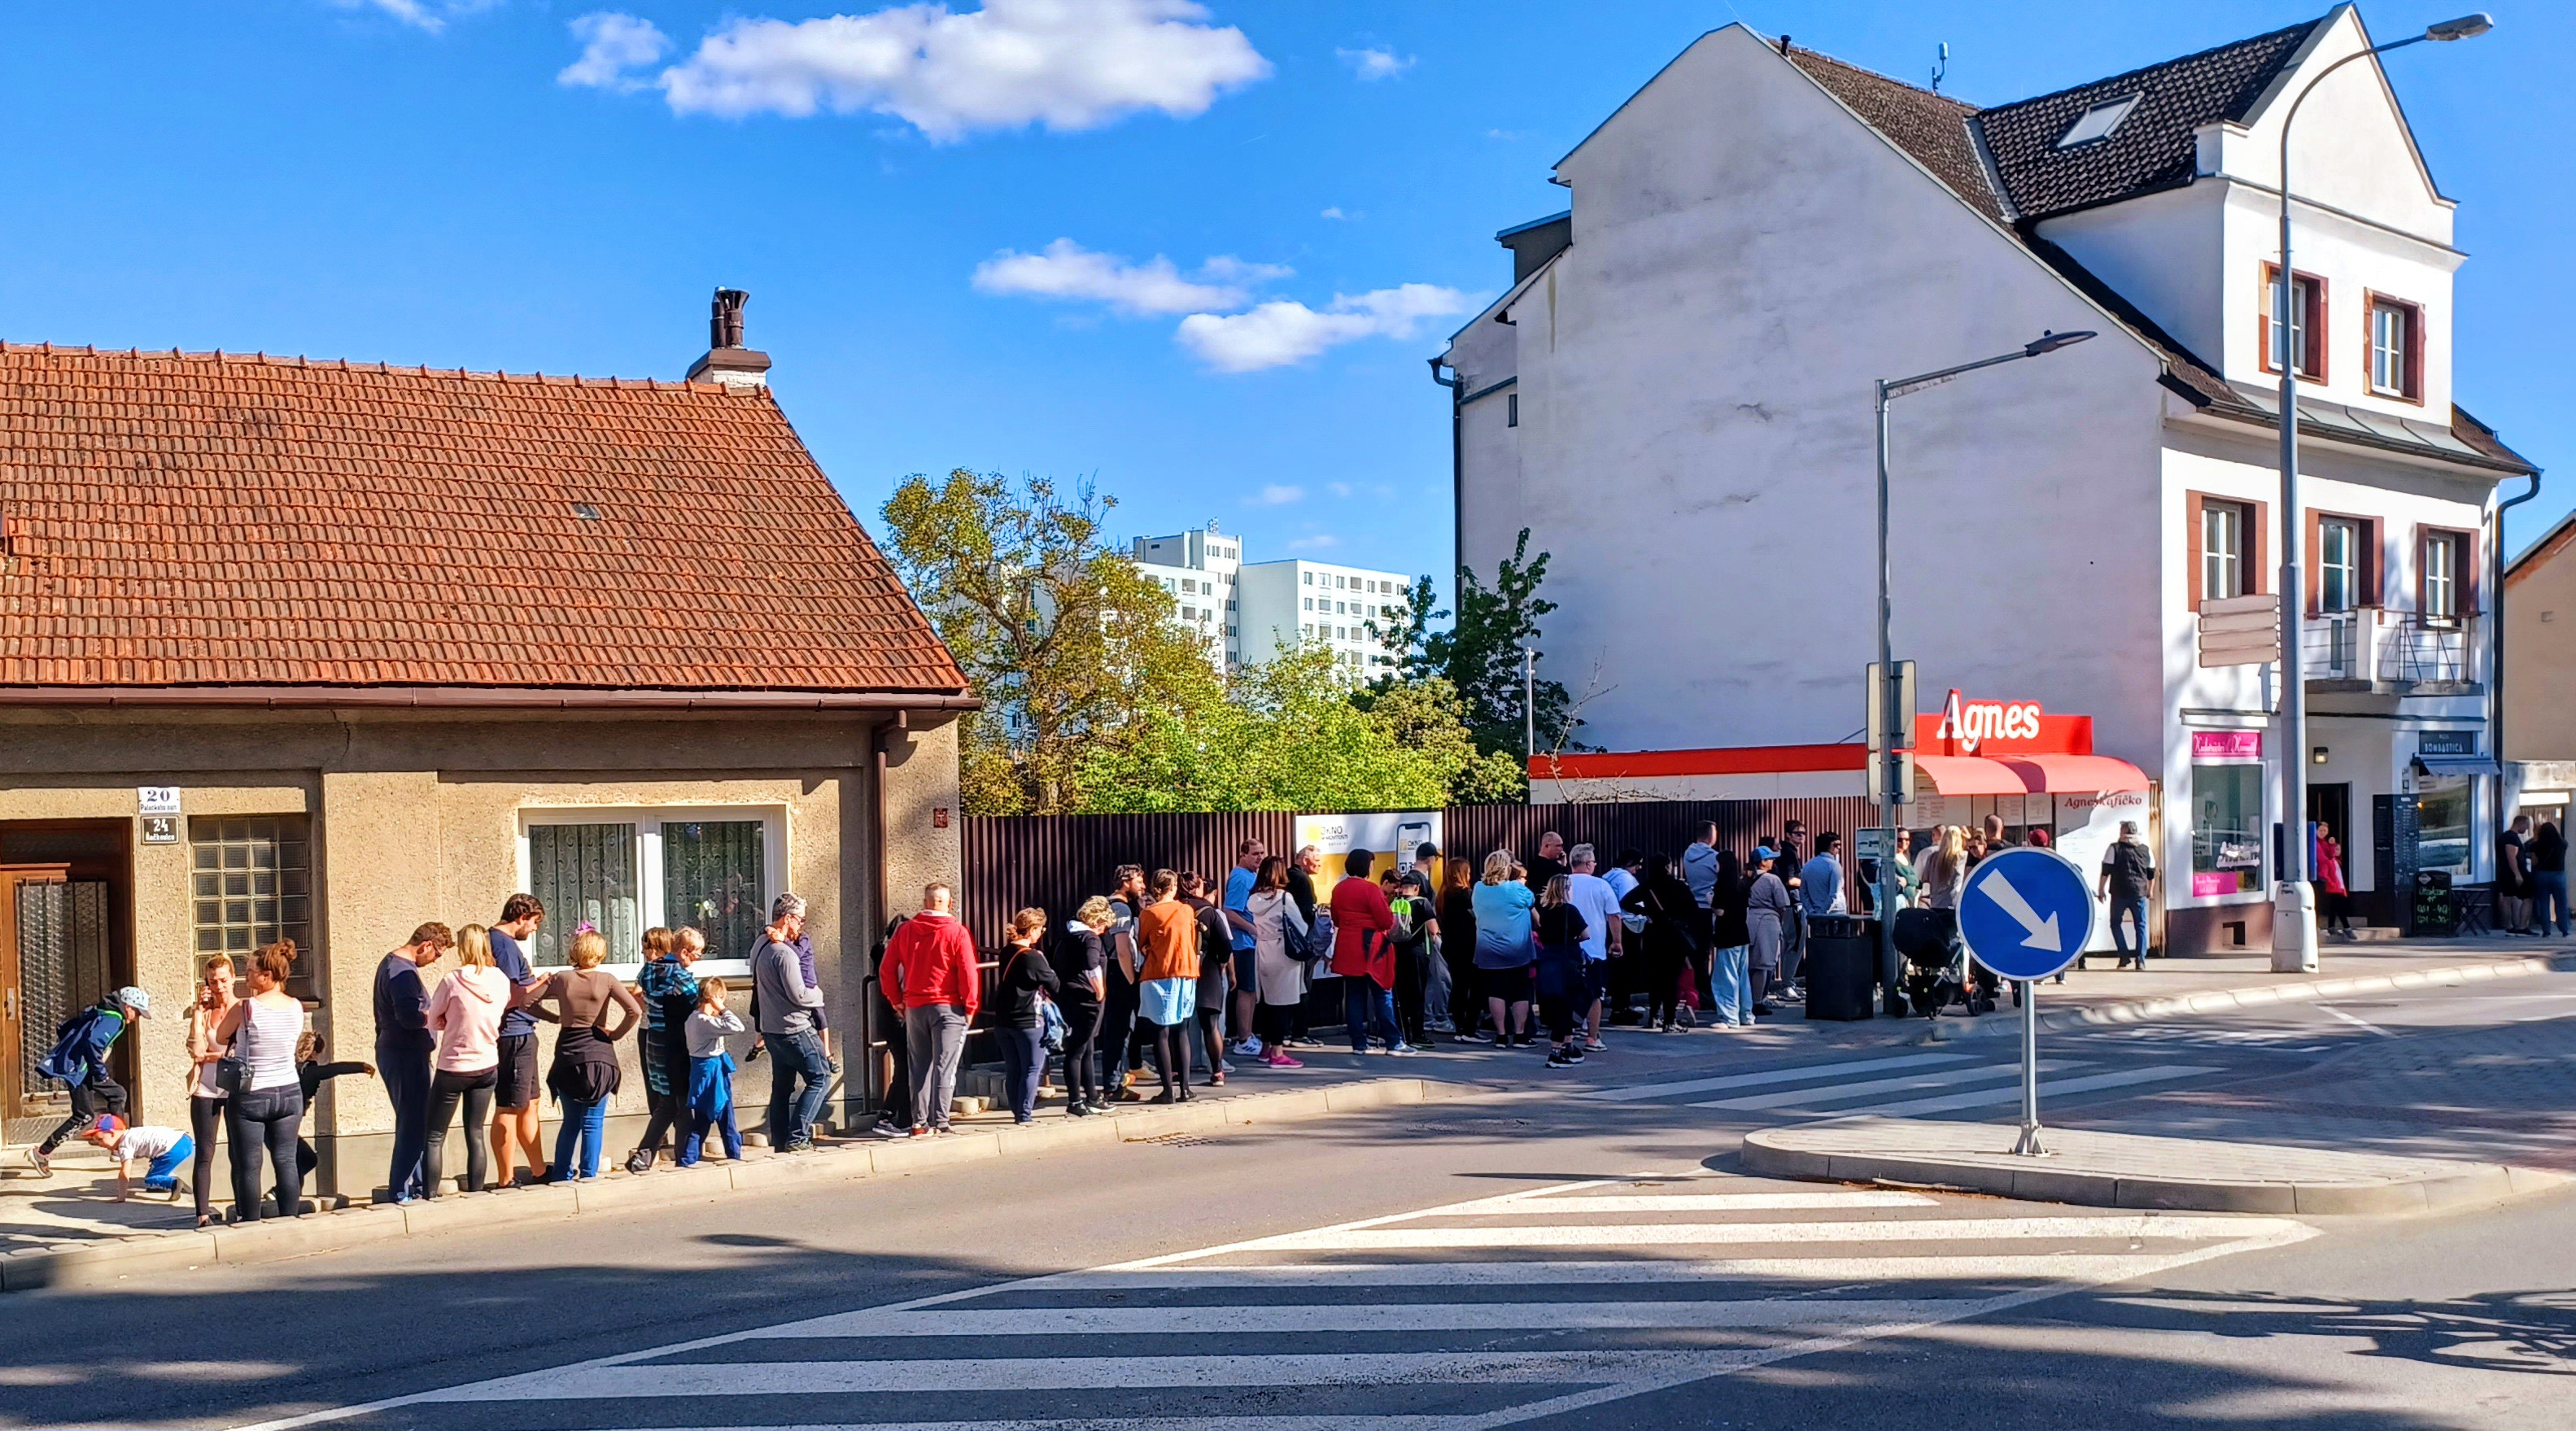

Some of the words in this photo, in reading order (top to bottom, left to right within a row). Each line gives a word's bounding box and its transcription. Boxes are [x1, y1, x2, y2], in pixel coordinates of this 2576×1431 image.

[1936, 693, 2040, 753] Agnes
[2425, 743, 2463, 753] BOMBASTICA
[147, 789, 170, 802] 20
[153, 818, 168, 832] 24
